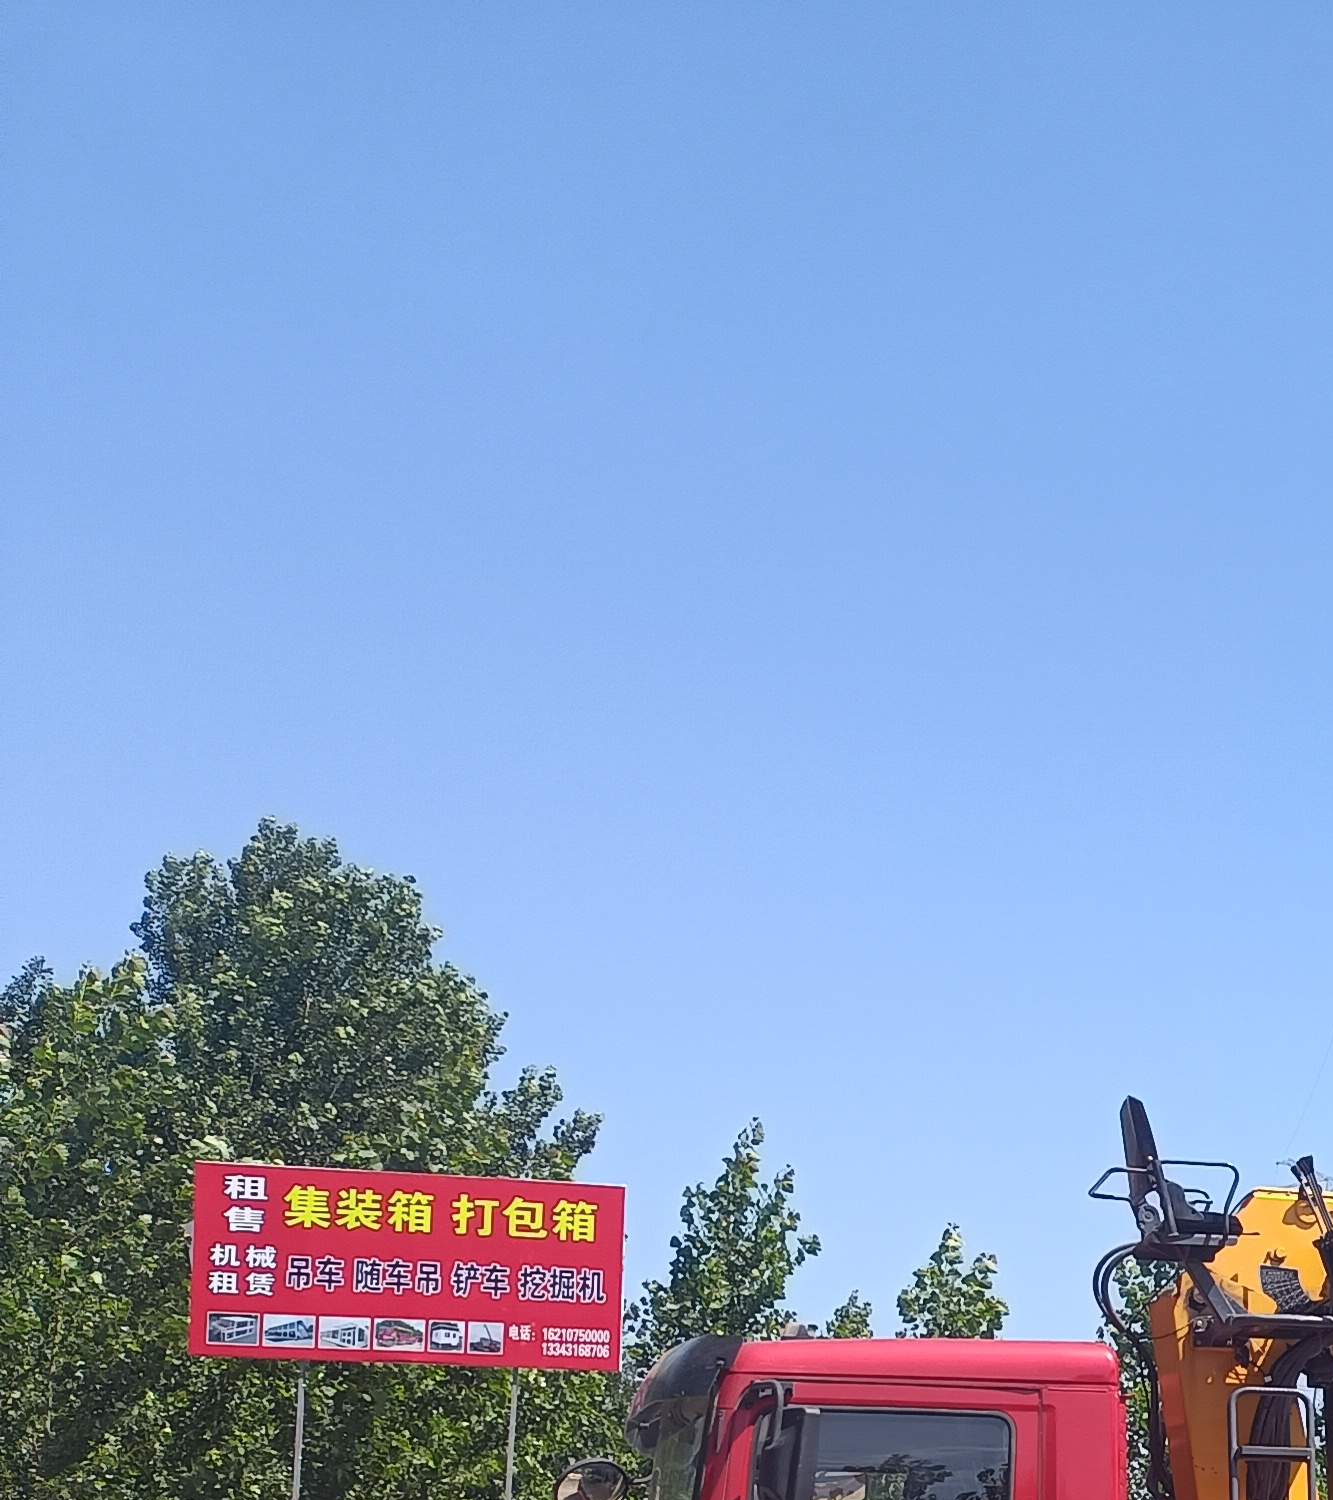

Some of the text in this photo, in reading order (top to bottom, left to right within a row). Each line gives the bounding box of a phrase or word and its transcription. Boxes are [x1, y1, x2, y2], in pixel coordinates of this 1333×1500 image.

[283, 1185, 598, 1242] 集装箱 打包箱
[209, 1243, 277, 1269] 机械
[208, 1271, 276, 1297] 租赁
[286, 1256, 606, 1303] 吊车 随车吊 铲车 挖掘机
[542, 1327, 610, 1343] 16210750000
[541, 1343, 610, 1358] 13343168706
